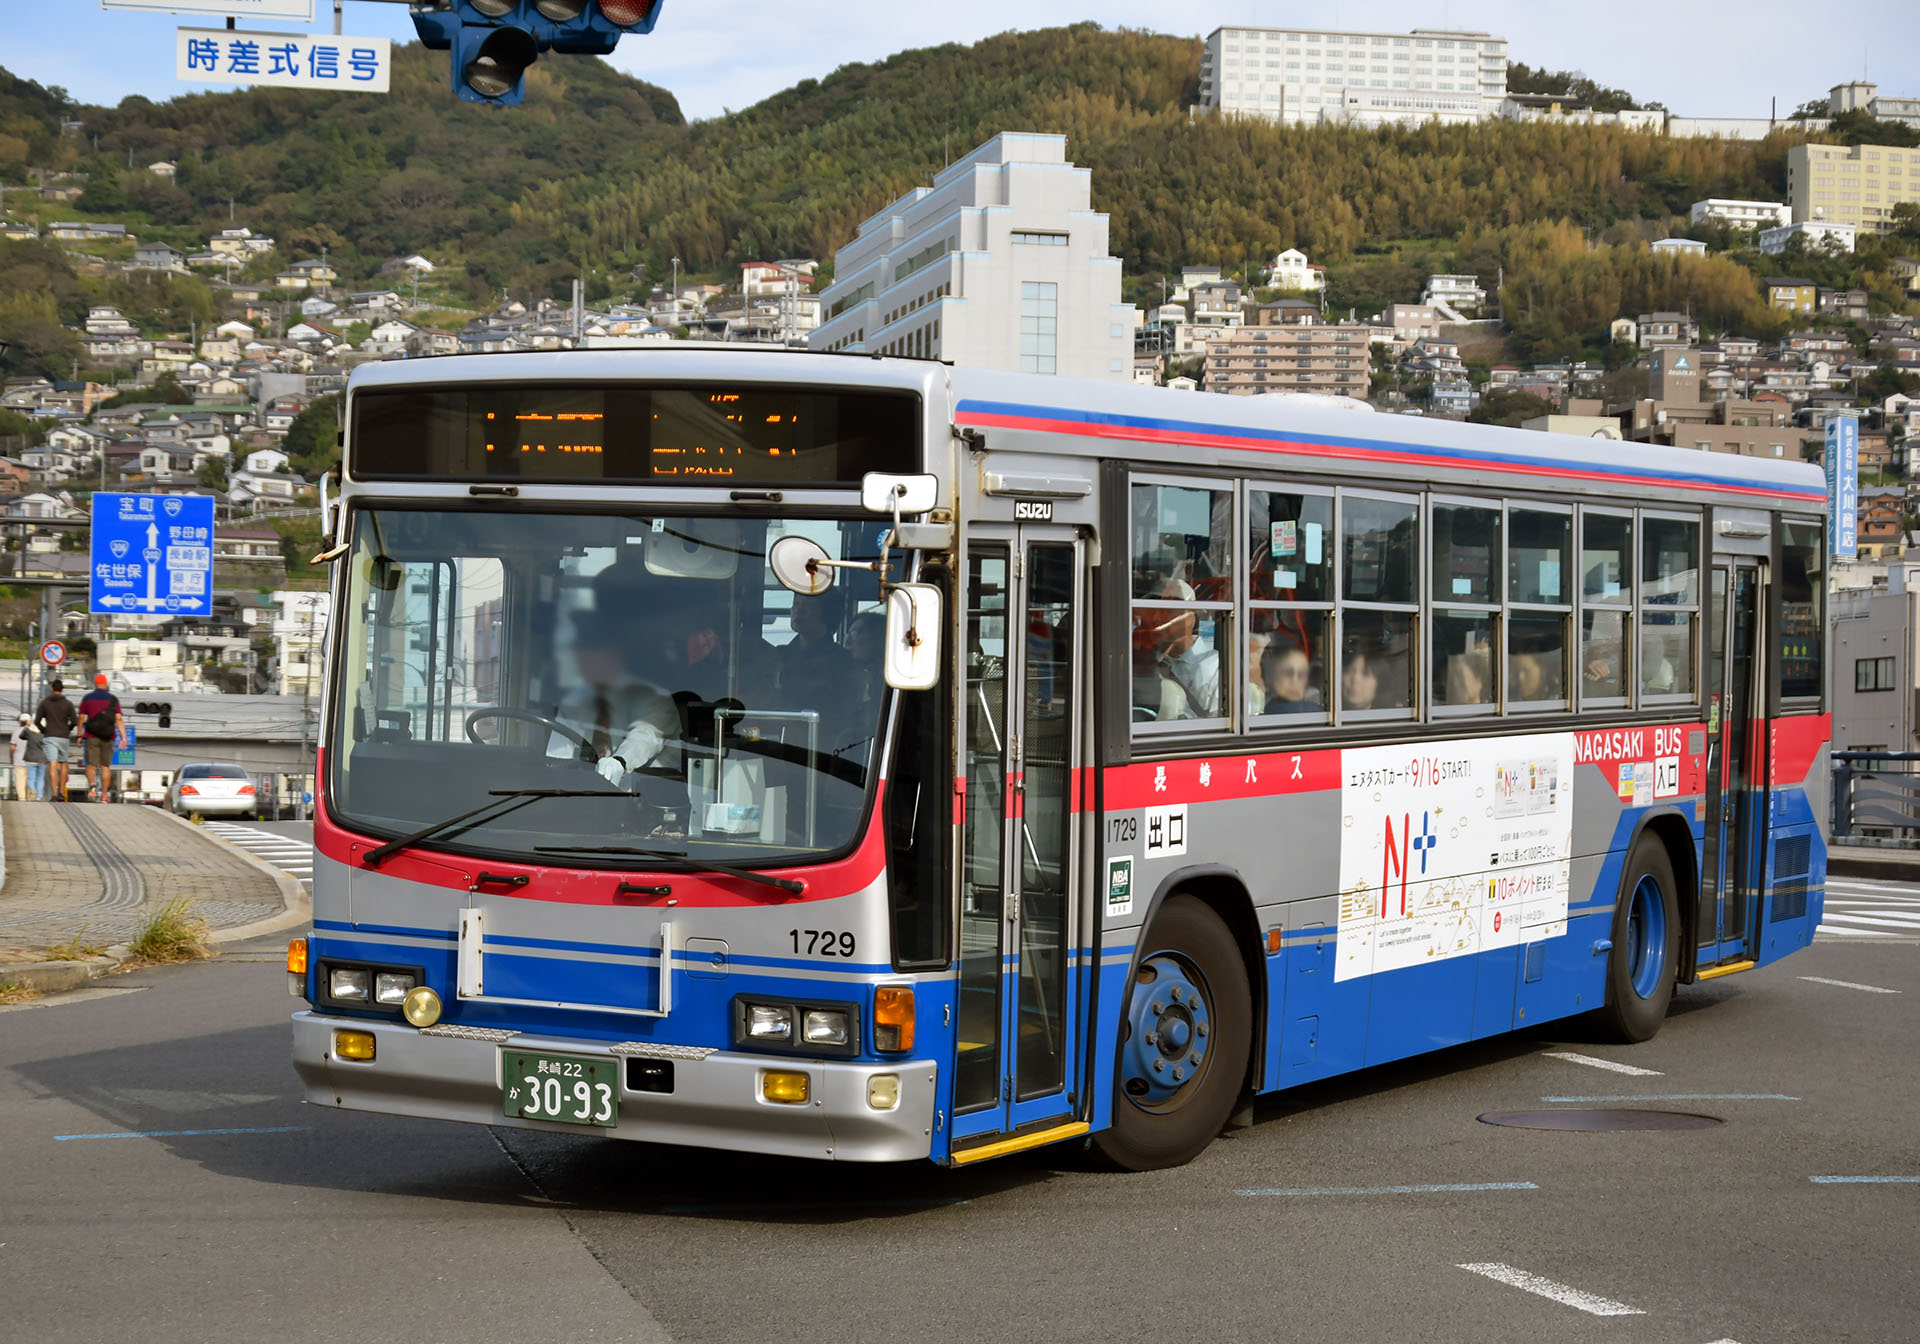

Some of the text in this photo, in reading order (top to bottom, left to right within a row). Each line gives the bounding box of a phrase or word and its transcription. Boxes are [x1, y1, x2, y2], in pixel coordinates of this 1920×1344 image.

[188, 38, 379, 81] 時差式信号
[120, 496, 154, 512] 宝町
[1015, 502, 1052, 519] ISUZU
[96, 563, 142, 578] 佐世保
[1574, 727, 1682, 762] NAGASAKI BUS
[1154, 755, 1303, 792] 長崎バス
[1411, 756, 1440, 788] 9/16
[1441, 760, 1471, 779] START!
[1657, 764, 1677, 790] 入口
[1107, 817, 1137, 843] 1729
[1148, 813, 1184, 850] 出口
[1112, 869, 1128, 884] NBA
[789, 929, 856, 957] 1729
[509, 1076, 612, 1121] か 30-93
